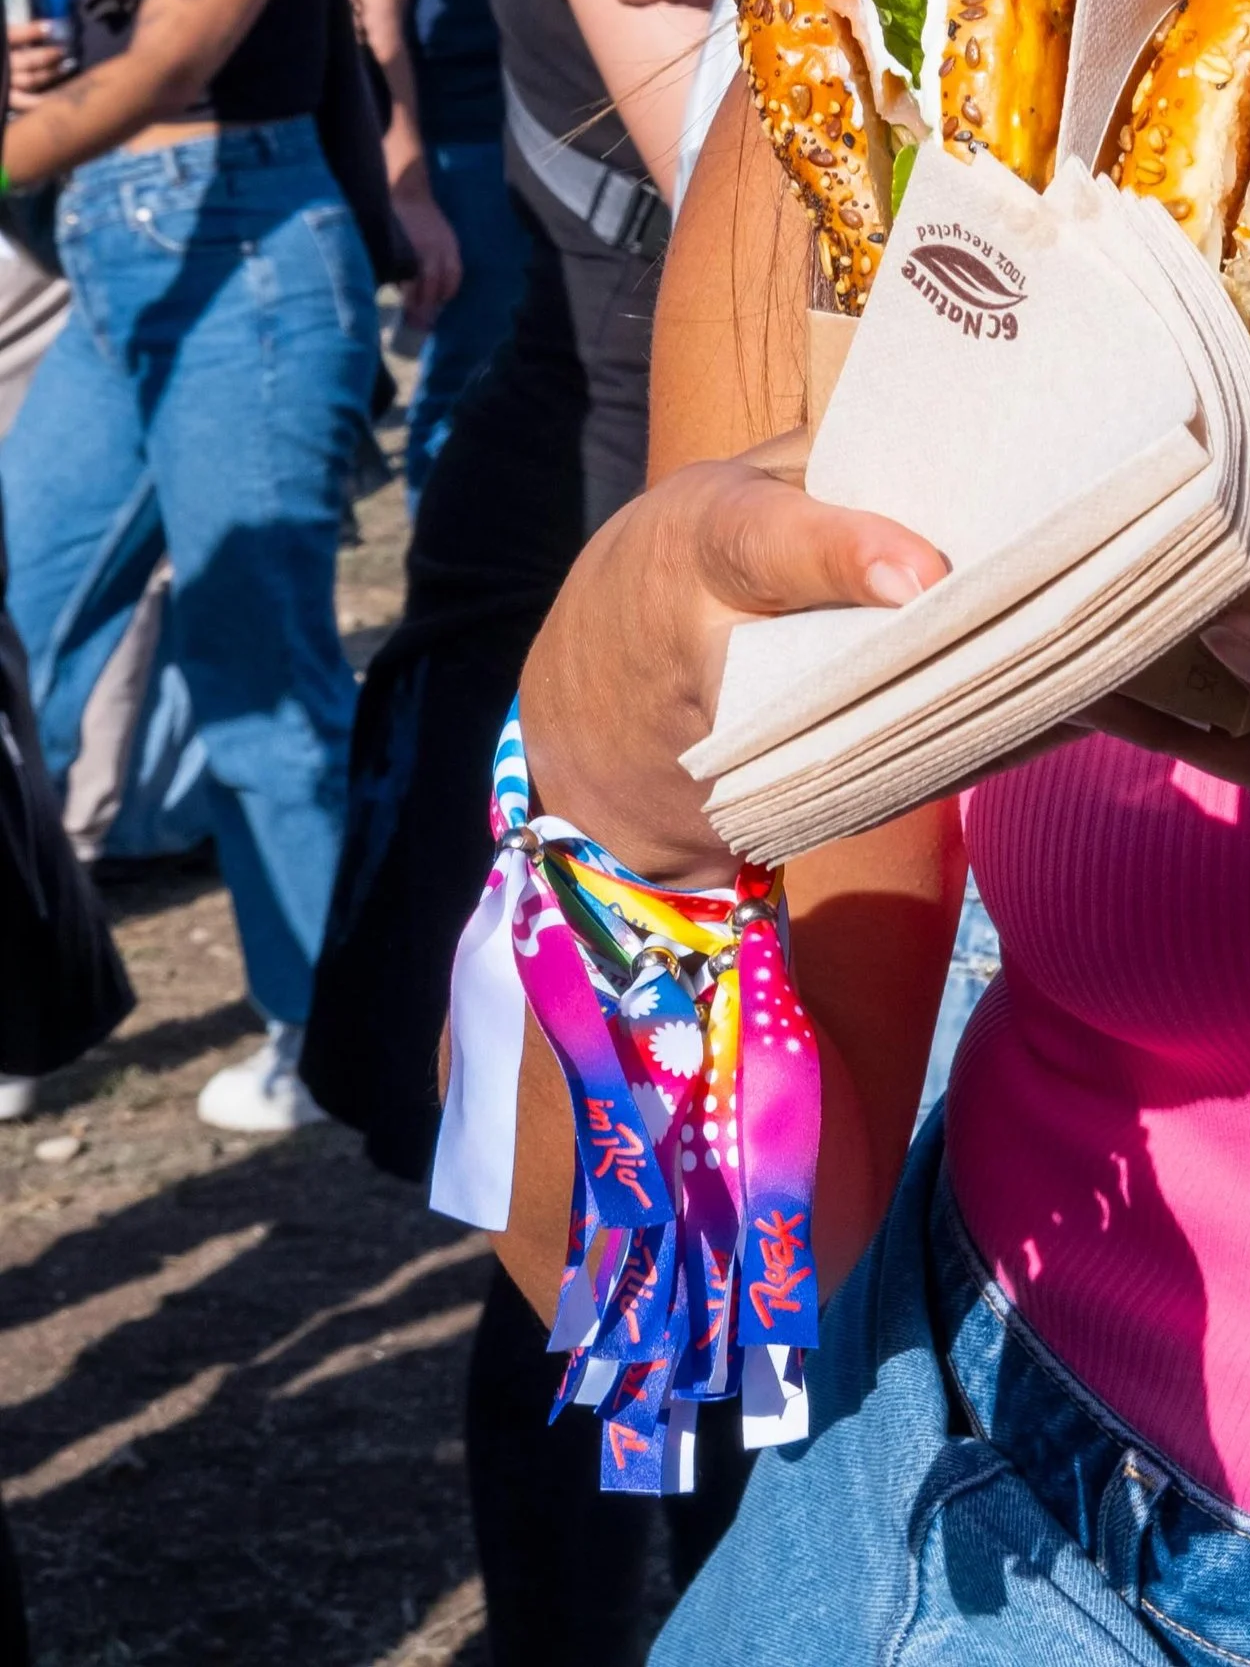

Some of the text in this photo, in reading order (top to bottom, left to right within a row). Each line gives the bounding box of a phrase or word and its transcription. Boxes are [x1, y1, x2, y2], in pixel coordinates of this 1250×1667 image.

[916, 223, 1026, 290] 100% Recycled
[749, 1209, 812, 1329] Rock
